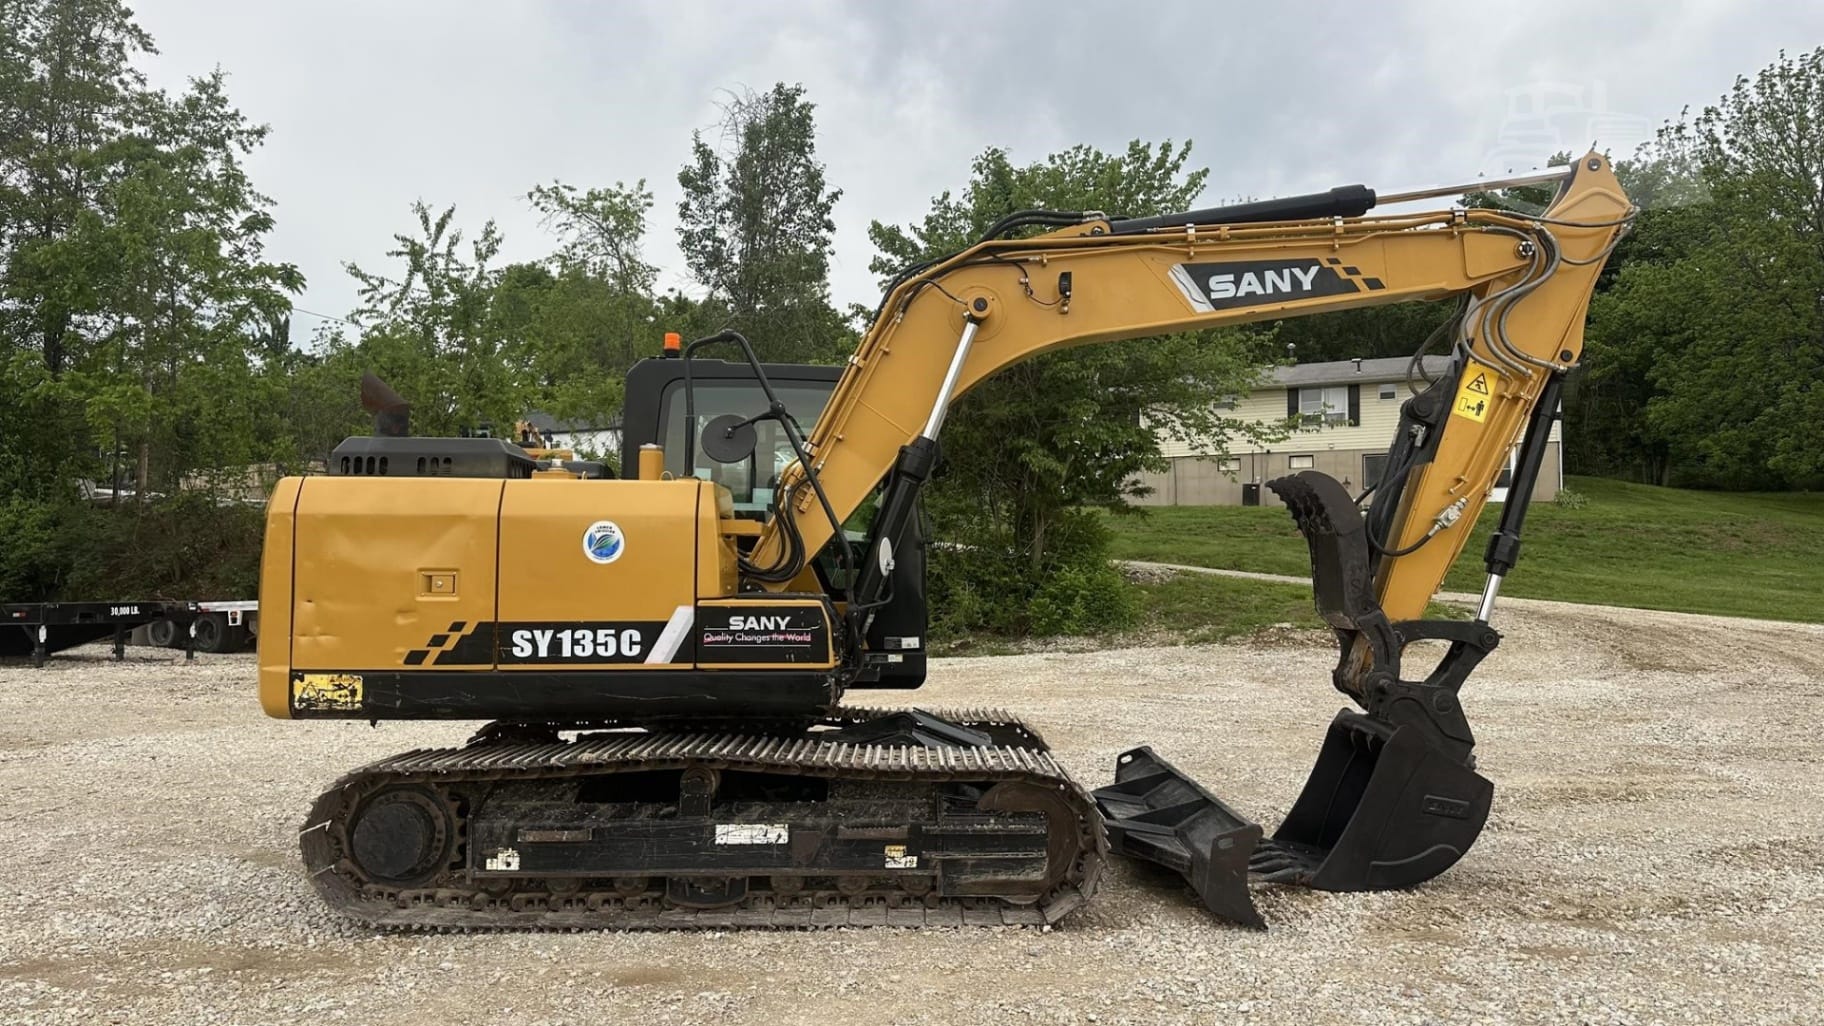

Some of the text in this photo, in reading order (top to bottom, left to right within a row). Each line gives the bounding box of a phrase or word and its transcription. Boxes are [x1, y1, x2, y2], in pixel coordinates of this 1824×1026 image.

[1208, 265, 1320, 299] SANY
[728, 616, 791, 630] SANY
[512, 629, 641, 657] SY135C
[704, 632, 811, 643] Quality Changes the World
